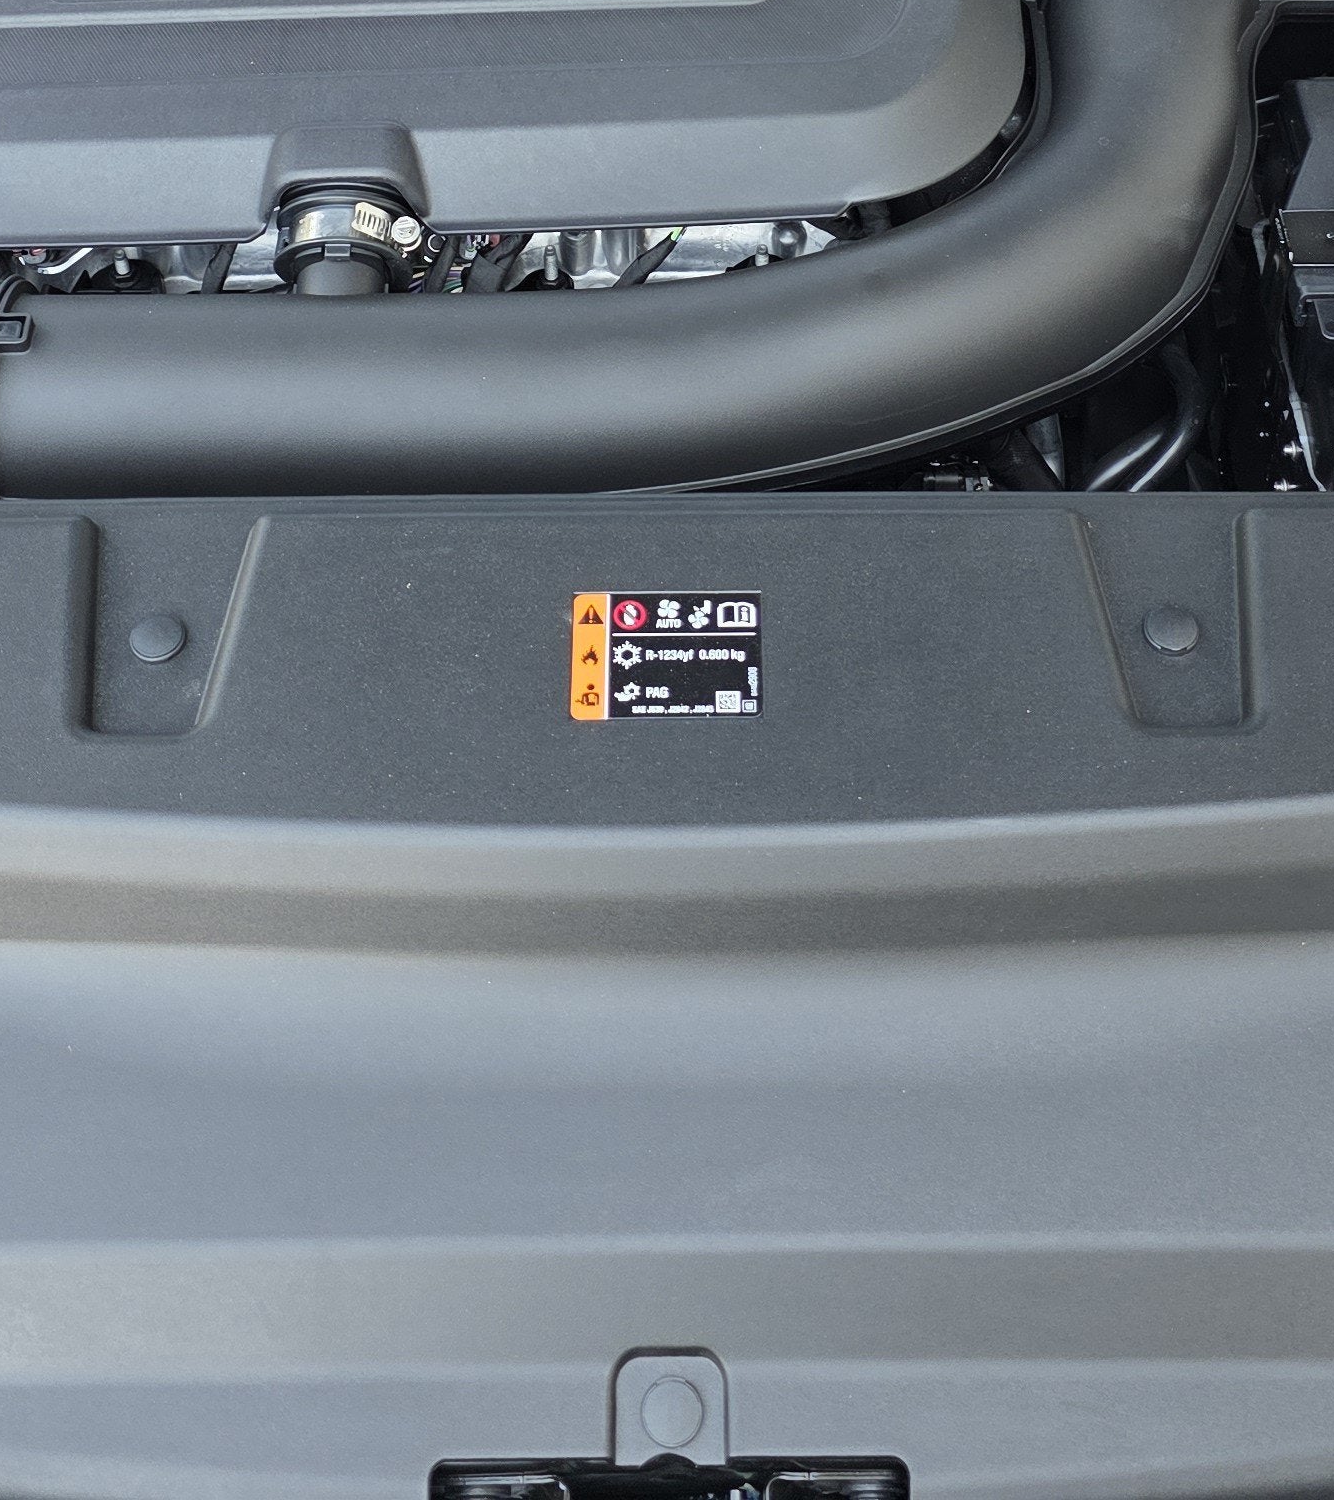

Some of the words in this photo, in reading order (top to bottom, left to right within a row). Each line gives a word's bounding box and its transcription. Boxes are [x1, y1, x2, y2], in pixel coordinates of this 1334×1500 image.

[656, 618, 682, 629] AUTO
[645, 649, 694, 662] R-1234yf
[730, 648, 746, 662] kg
[645, 686, 669, 698] PAG
